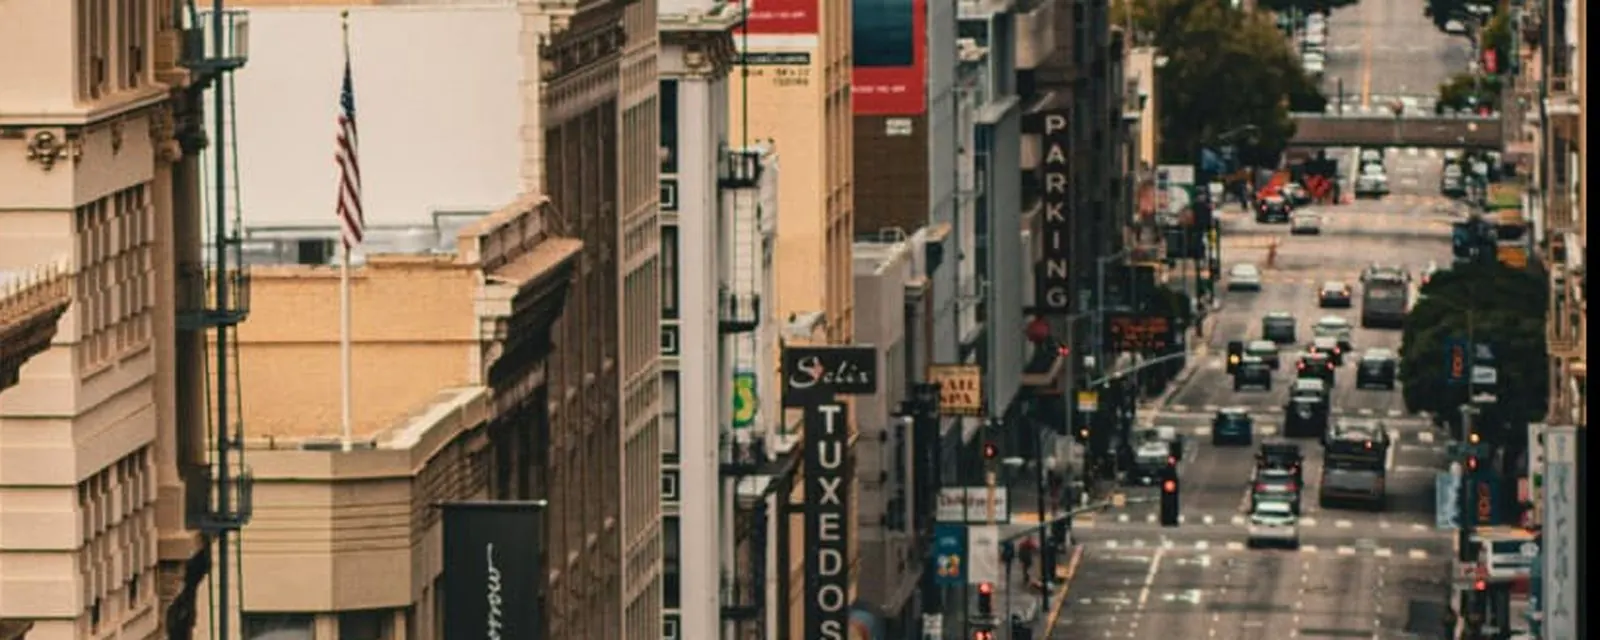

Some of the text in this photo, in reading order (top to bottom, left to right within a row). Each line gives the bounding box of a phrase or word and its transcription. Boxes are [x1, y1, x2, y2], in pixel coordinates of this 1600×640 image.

[1045, 114, 1067, 308] PARKING
[789, 355, 872, 389] Selix
[817, 405, 844, 640] TUXEDOS
